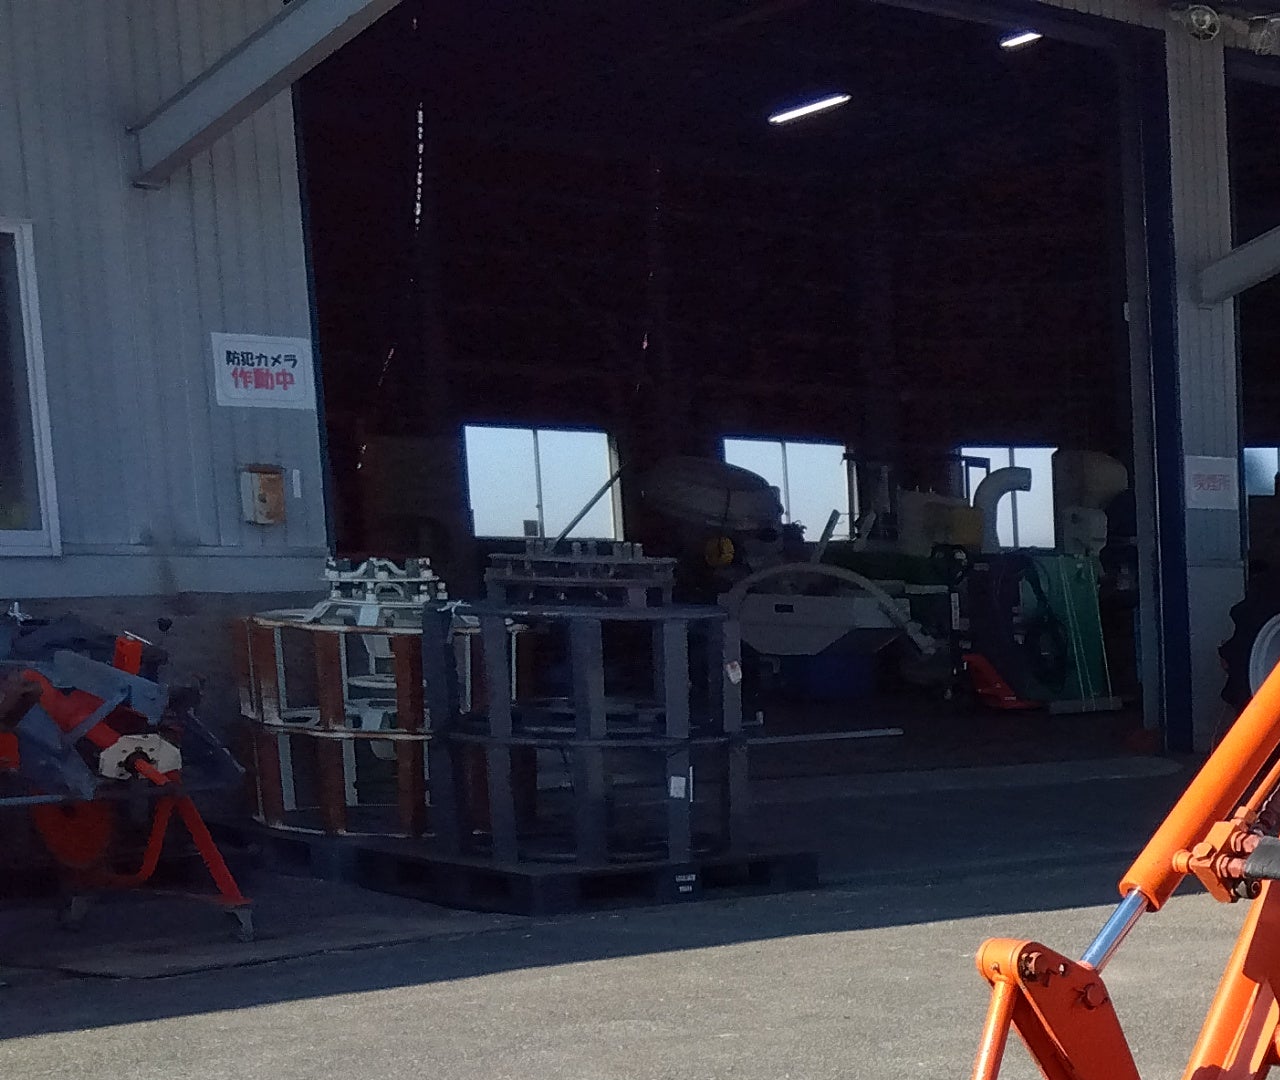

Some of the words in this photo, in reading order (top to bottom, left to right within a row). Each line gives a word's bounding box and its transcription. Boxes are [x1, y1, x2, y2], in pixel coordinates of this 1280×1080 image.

[226, 350, 298, 368] 防犯カメラ
[231, 367, 296, 390] 作動中
